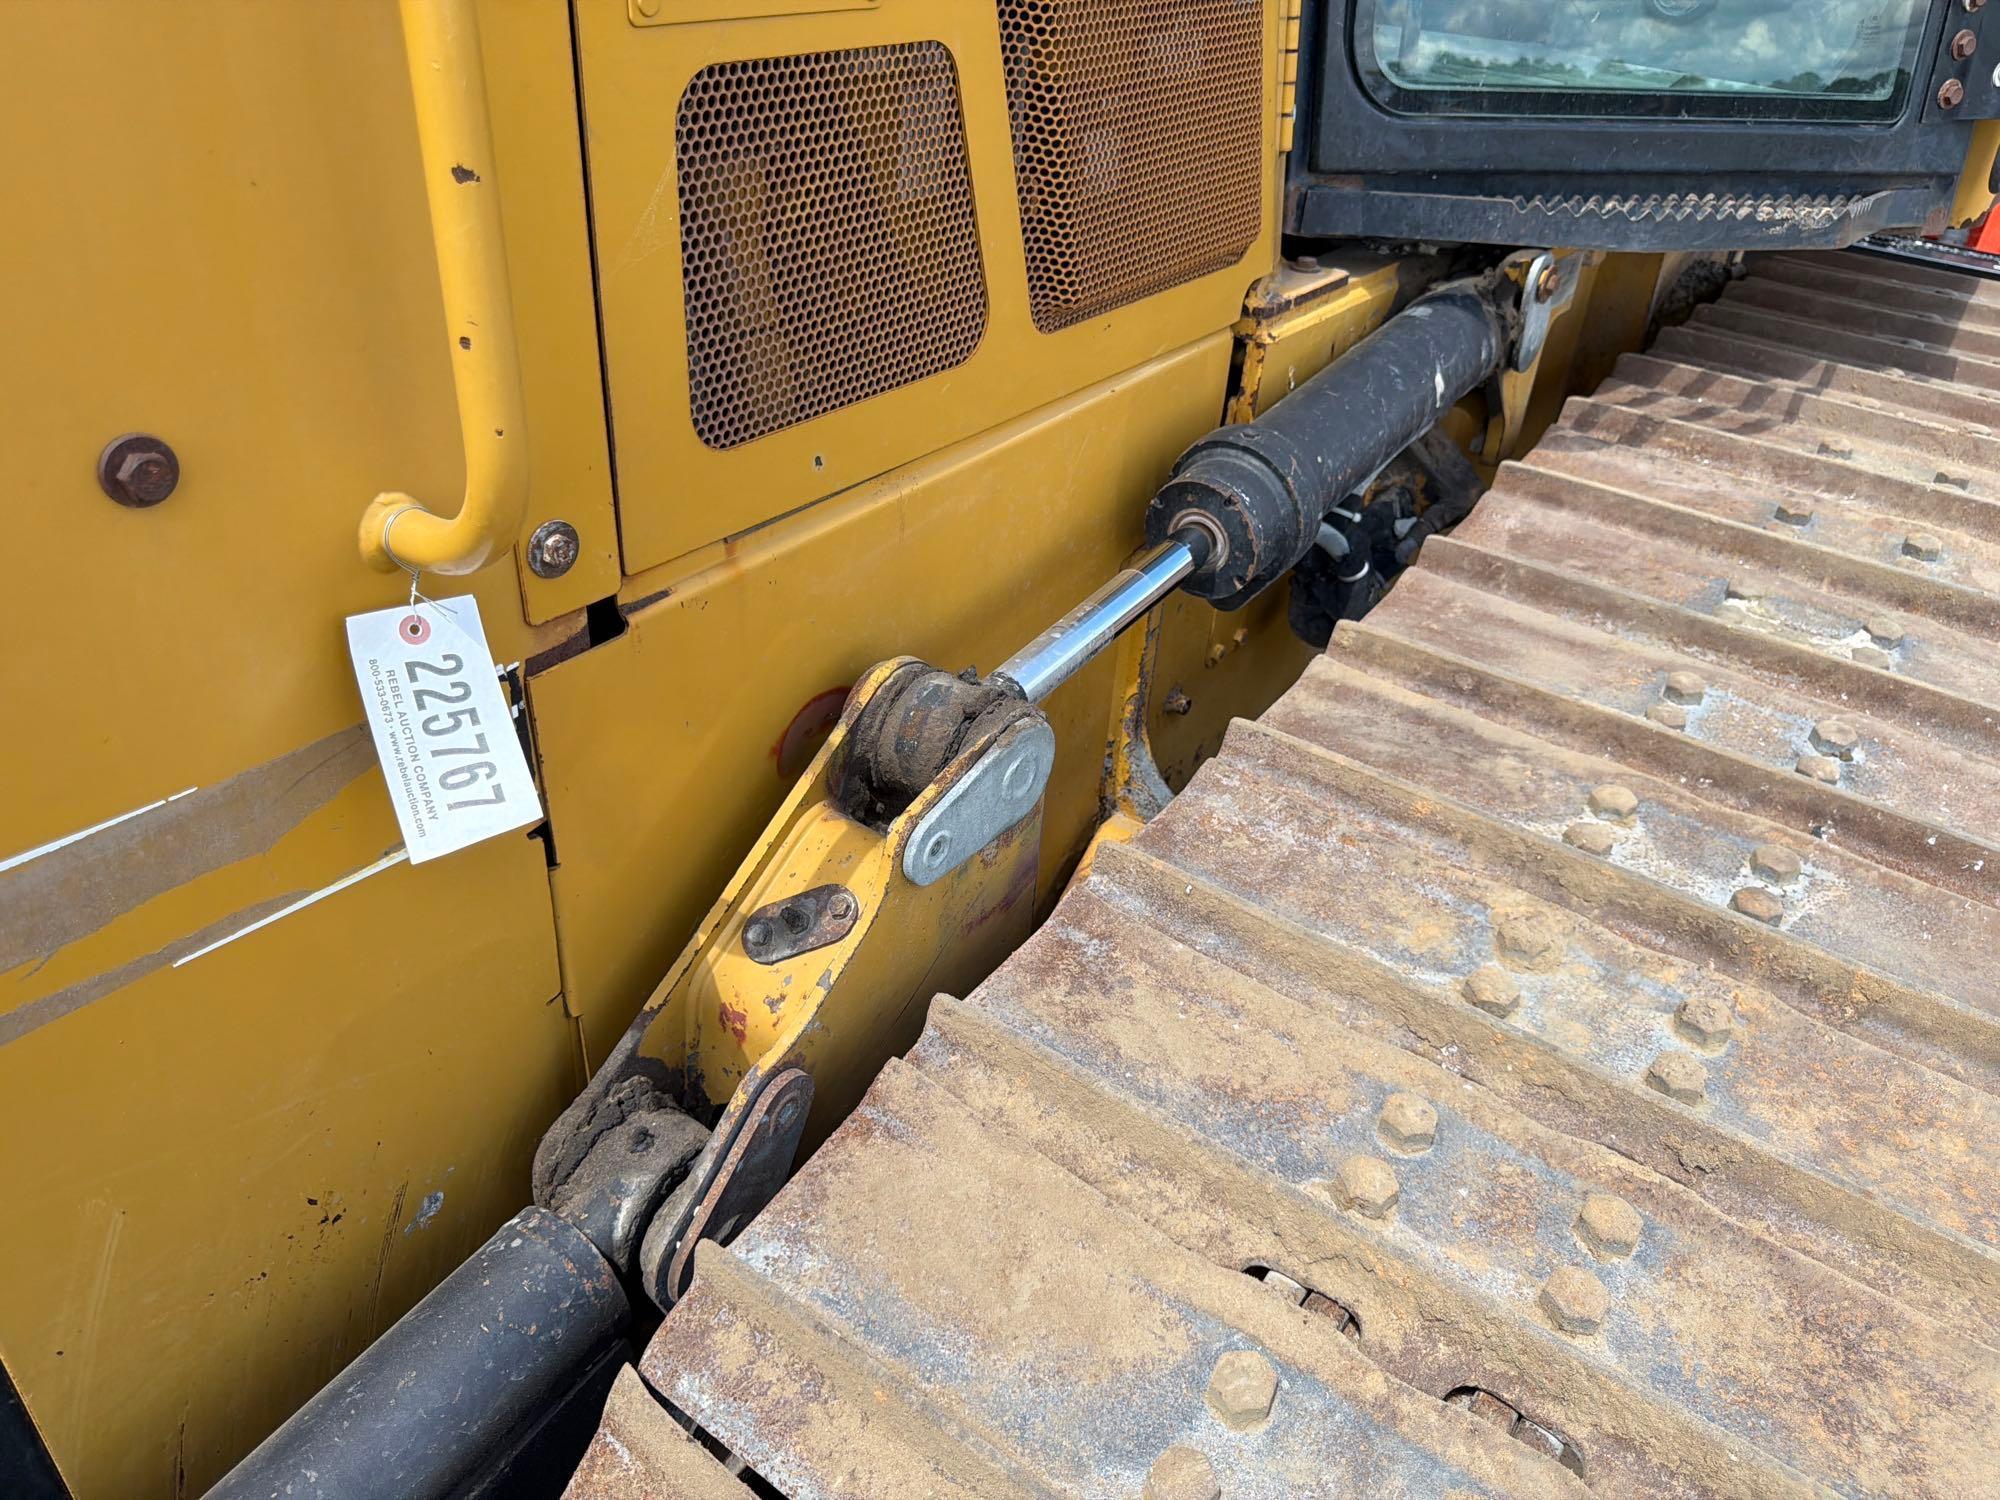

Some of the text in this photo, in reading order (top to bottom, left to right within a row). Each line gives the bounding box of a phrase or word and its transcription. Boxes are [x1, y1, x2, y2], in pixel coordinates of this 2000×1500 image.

[369, 659, 425, 837] 800-533-0673 www.rebelauction.com
[386, 669, 438, 820] REBEL AUCTION COMPANY
[405, 653, 506, 811] 225767
